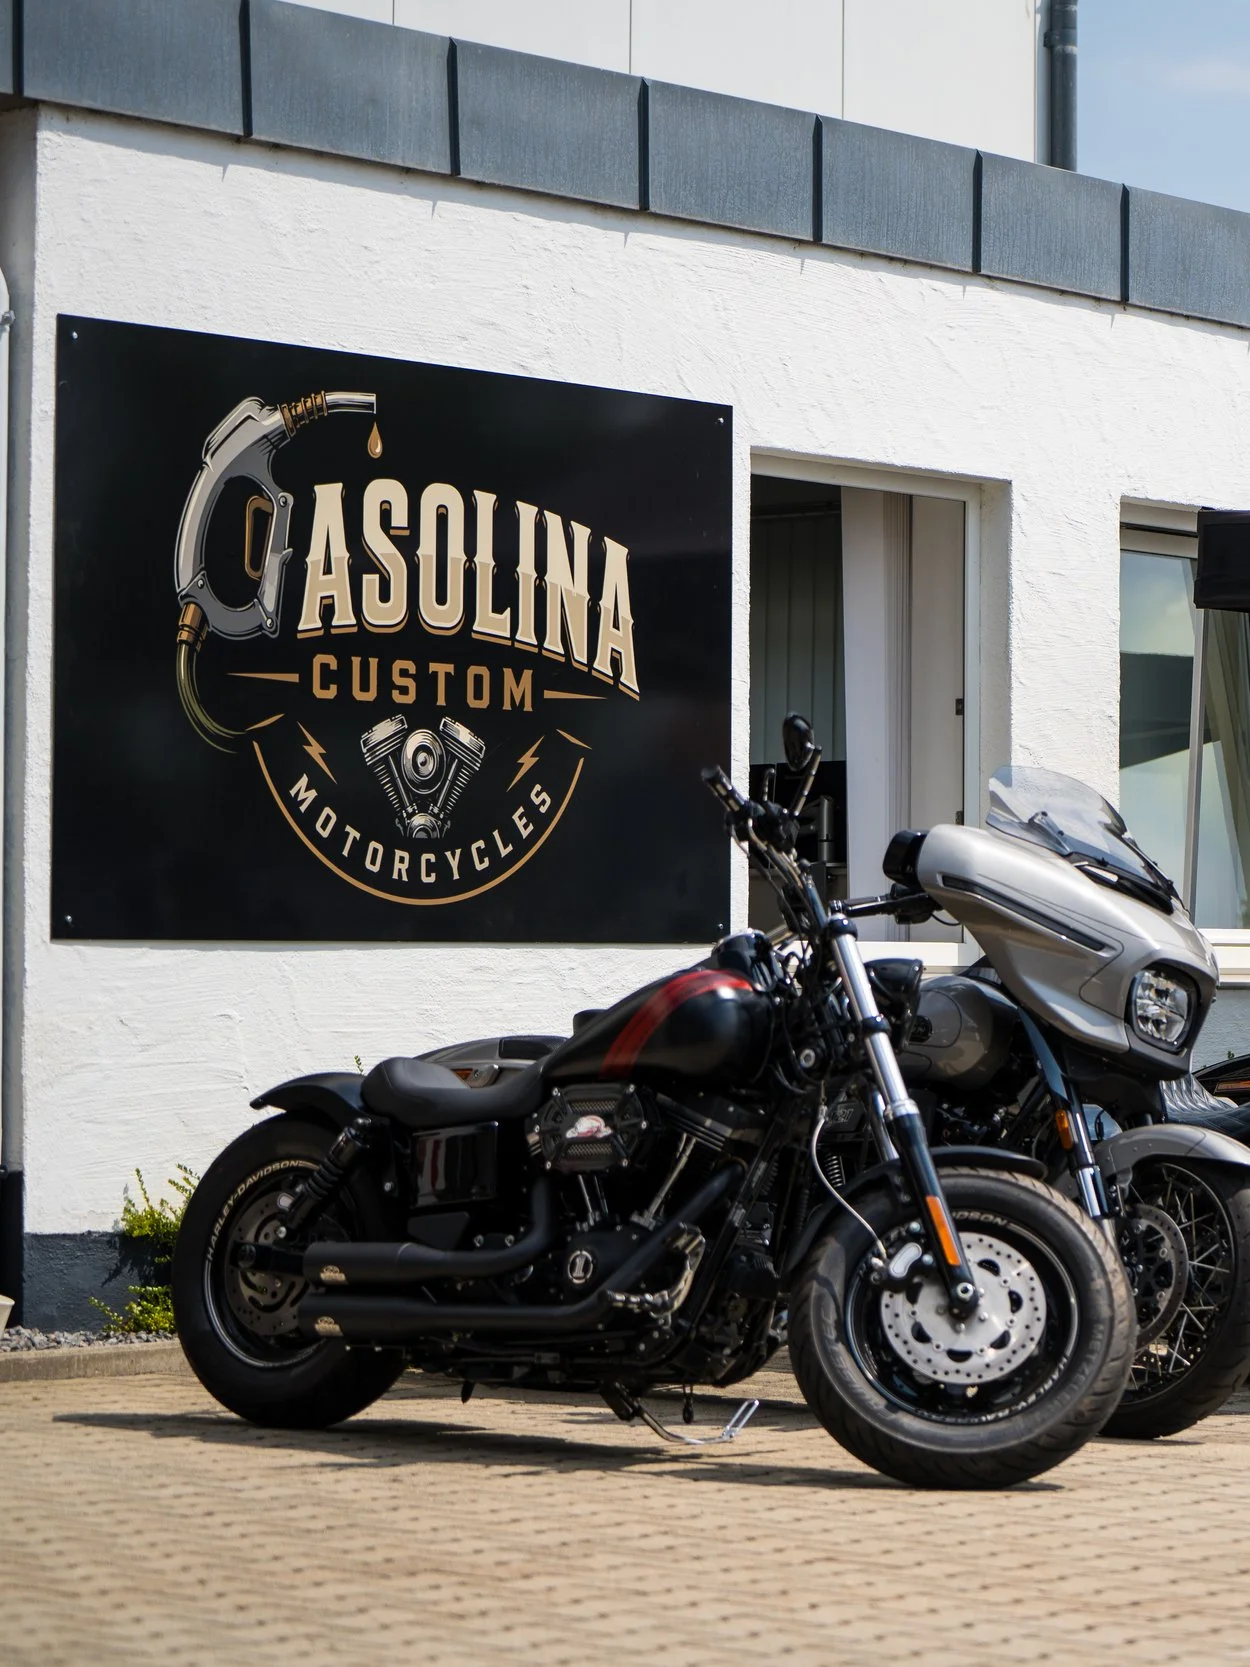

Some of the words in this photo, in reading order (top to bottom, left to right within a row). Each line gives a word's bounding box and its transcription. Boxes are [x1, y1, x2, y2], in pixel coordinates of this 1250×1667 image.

[312, 652, 534, 712] CUSTOM
[289, 773, 552, 883] MOTORCYCLES
[206, 1159, 301, 1261] HARLEY-DAVIDSON
